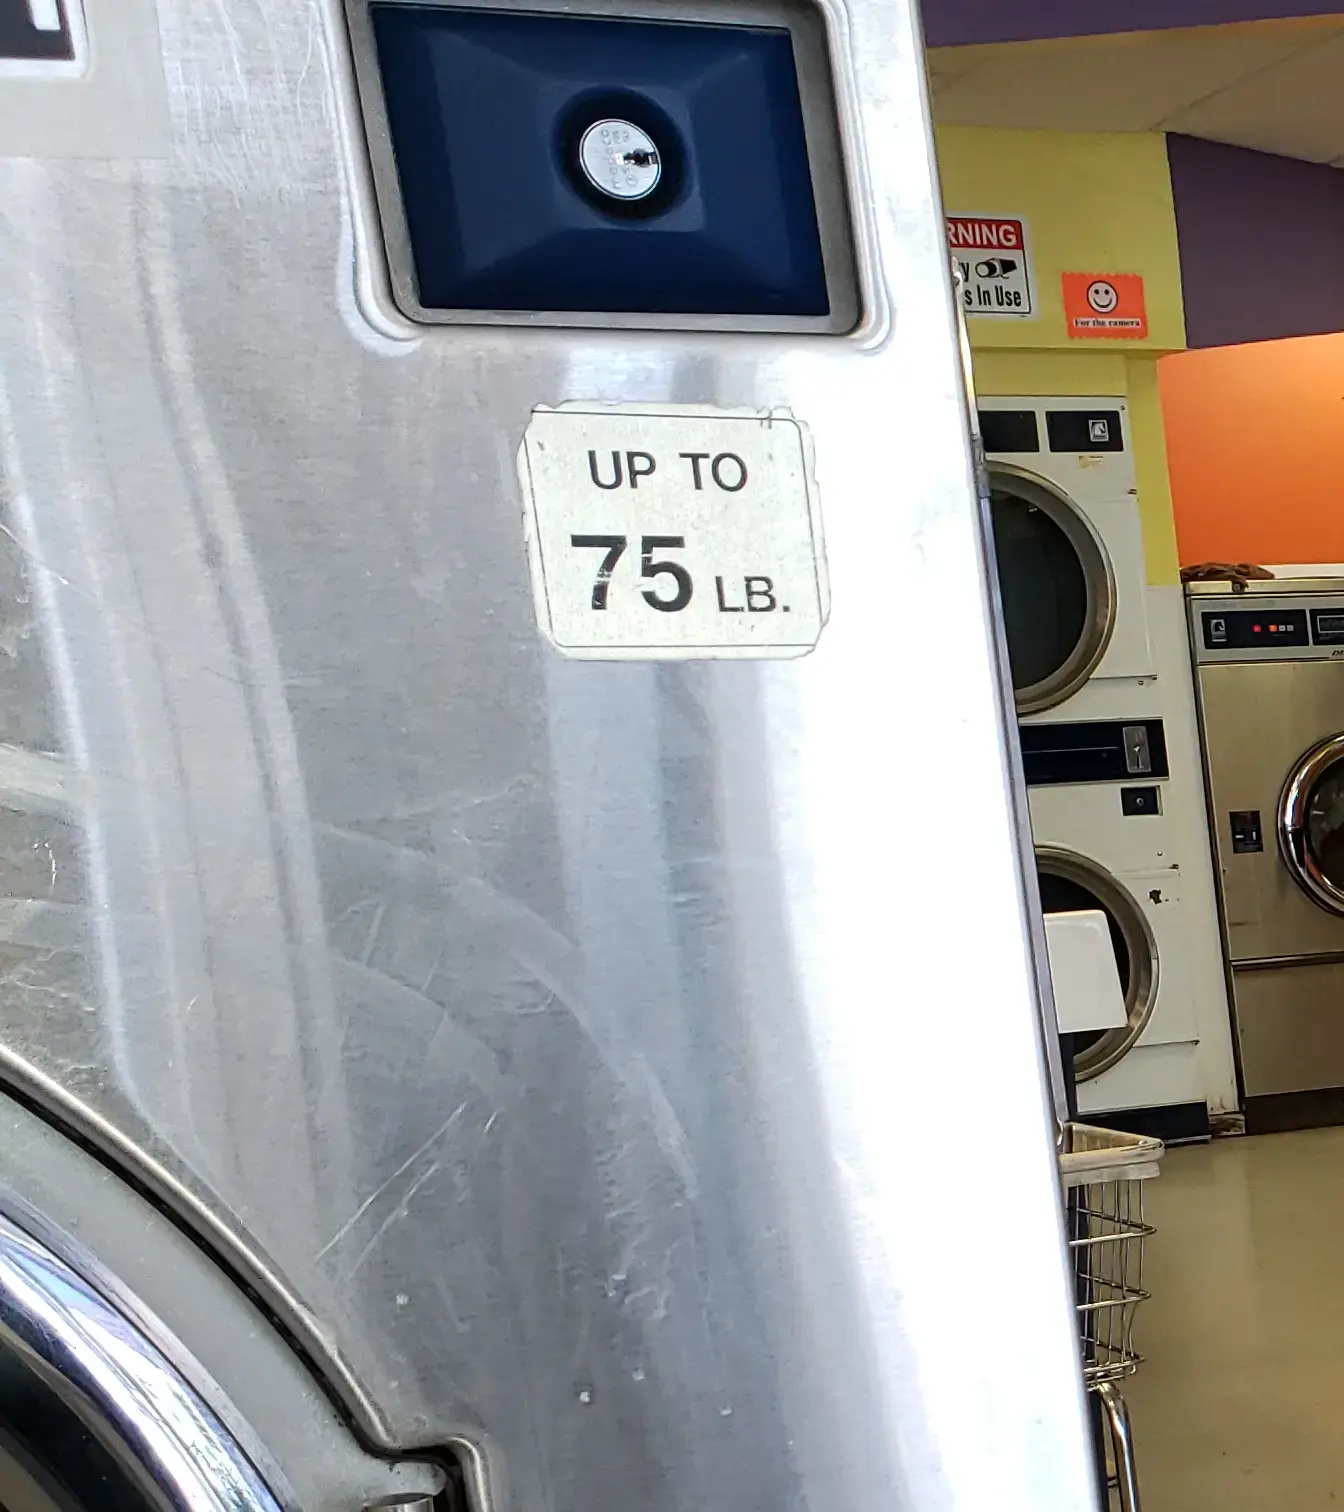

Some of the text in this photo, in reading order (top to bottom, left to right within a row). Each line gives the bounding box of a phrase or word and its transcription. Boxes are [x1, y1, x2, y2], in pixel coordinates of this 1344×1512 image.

[947, 222, 1017, 247] RNING
[976, 284, 992, 306] In
[994, 285, 1022, 307] Use
[1075, 319, 1140, 327] For the camera
[588, 450, 748, 492] UP TO
[571, 534, 790, 613] 75 LB.
